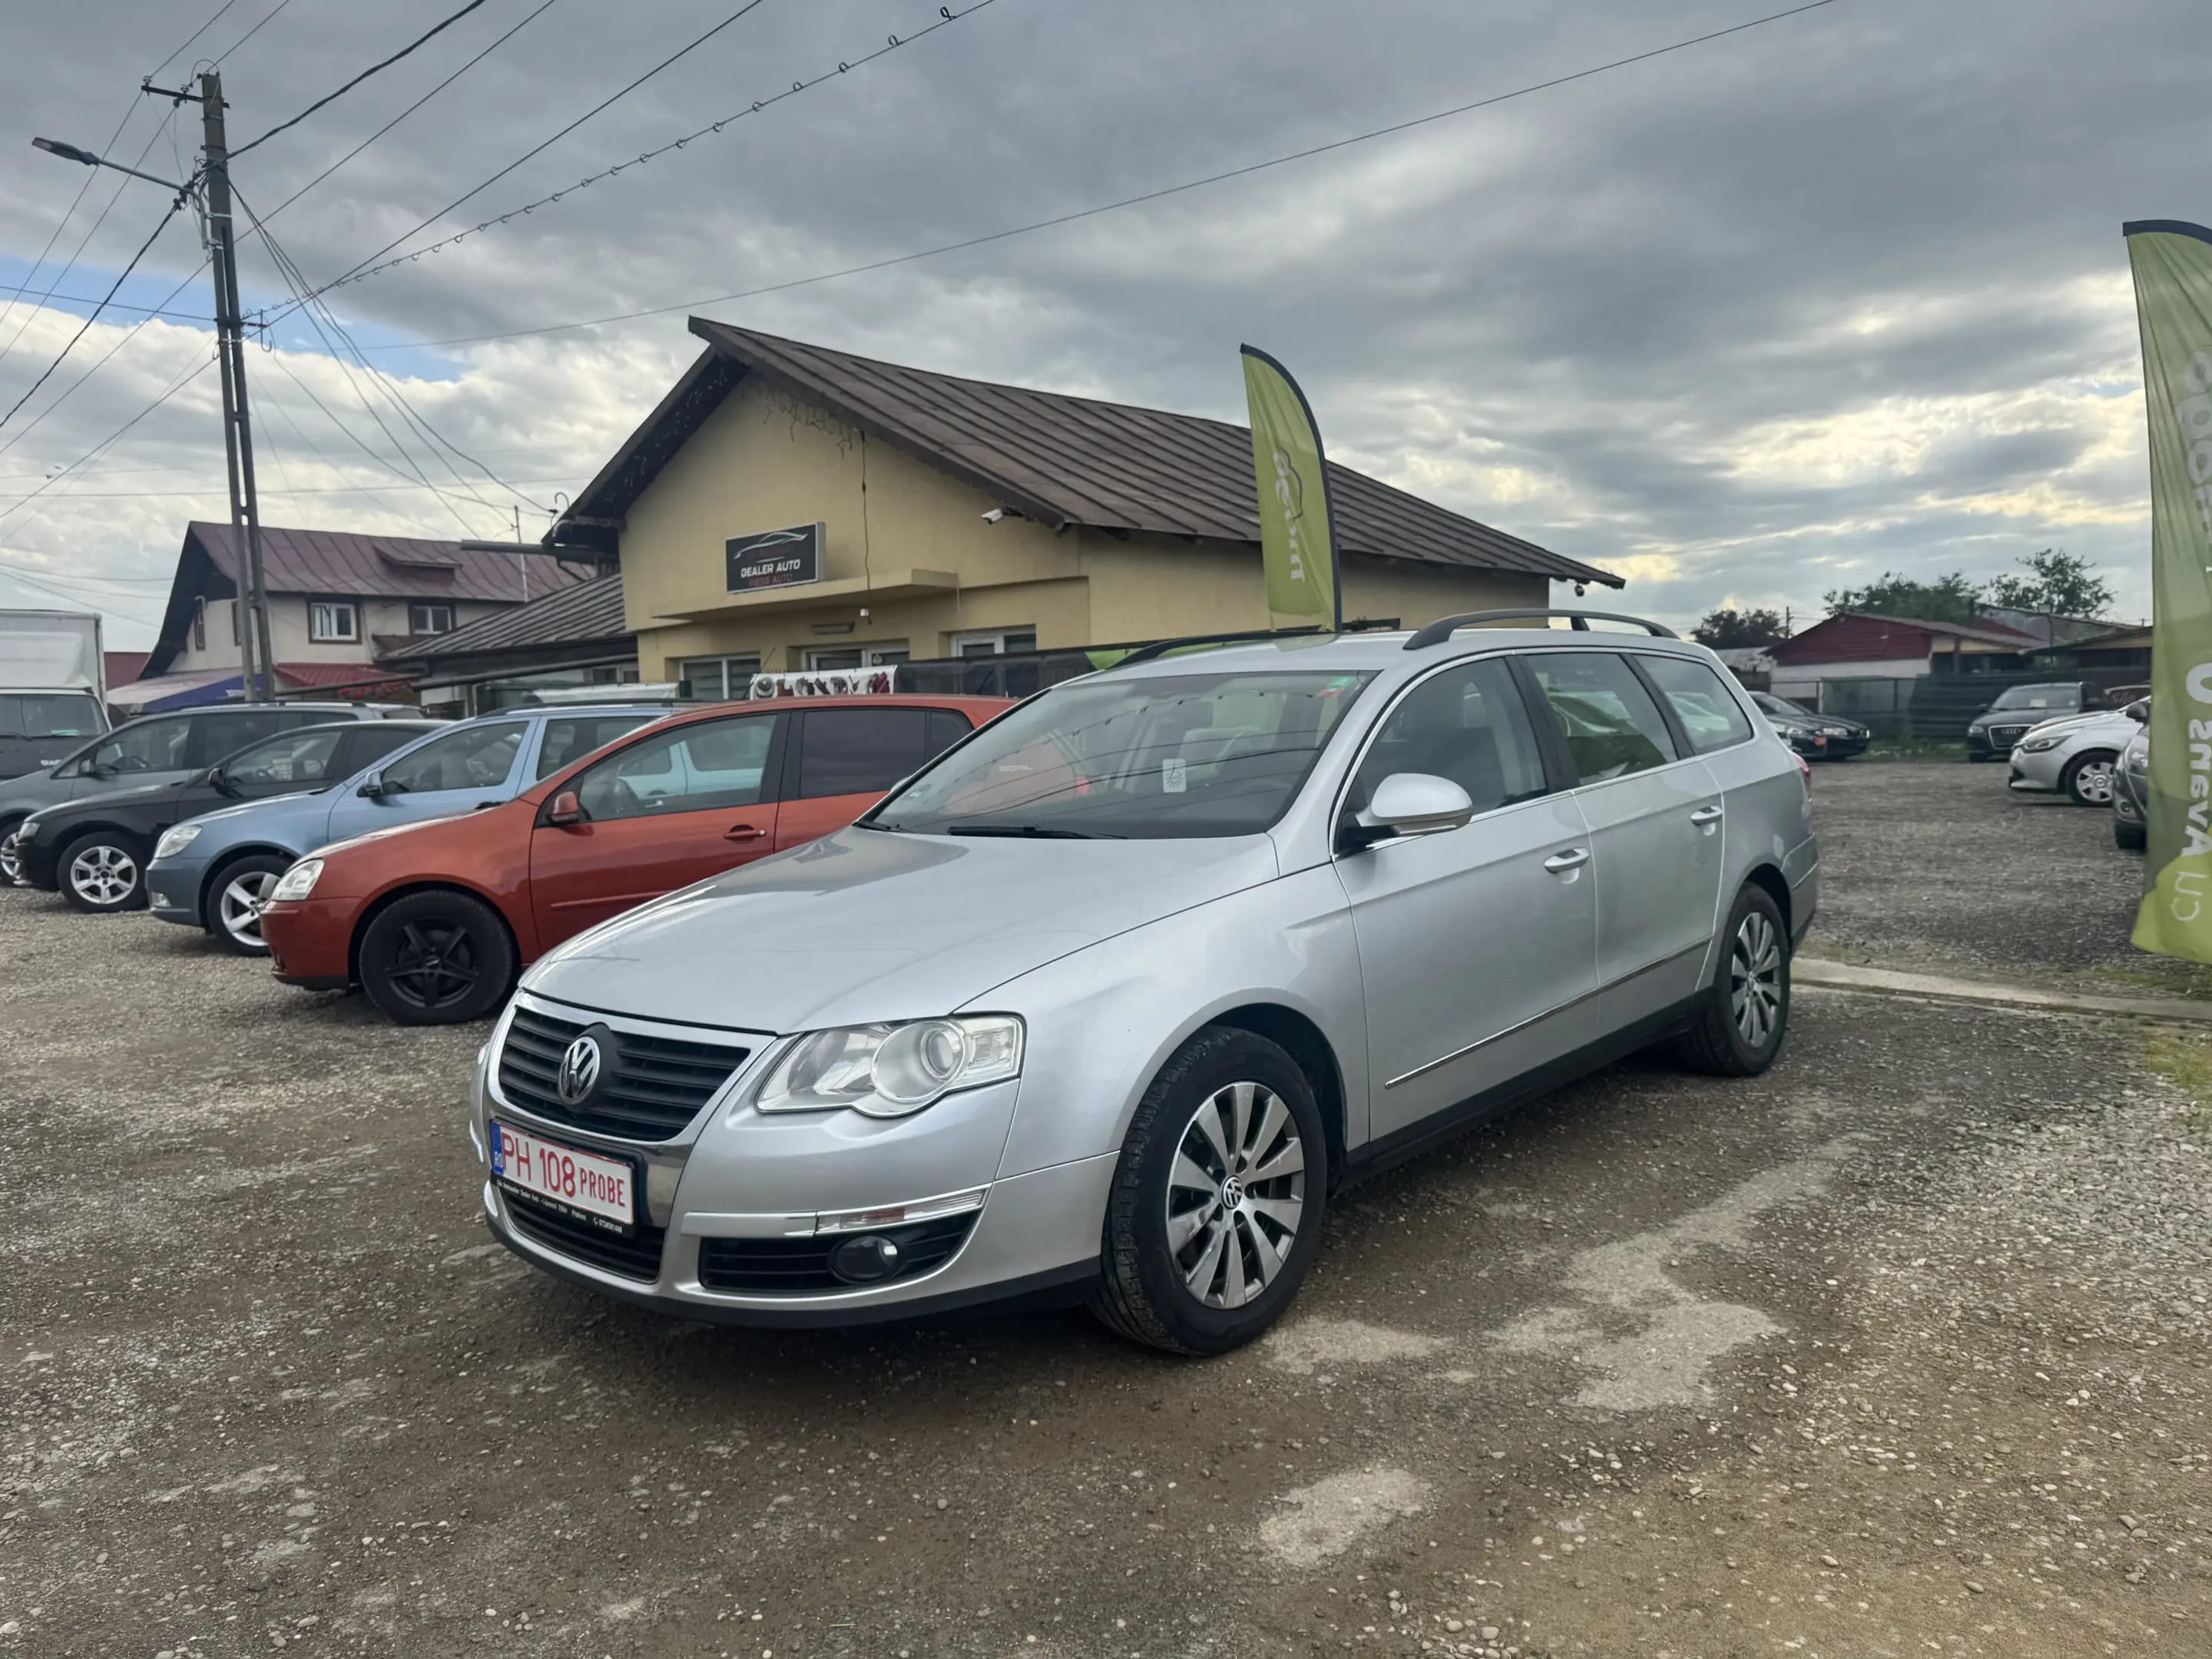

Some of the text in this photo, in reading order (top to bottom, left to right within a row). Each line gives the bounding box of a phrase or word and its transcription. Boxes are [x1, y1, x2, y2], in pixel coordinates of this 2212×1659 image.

[740, 558, 801, 578] DEALER AUTO
[494, 1151, 504, 1169] RO
[502, 1132, 531, 1182] PH
[539, 1147, 576, 1198] 108
[580, 1167, 626, 1208] PROBE
